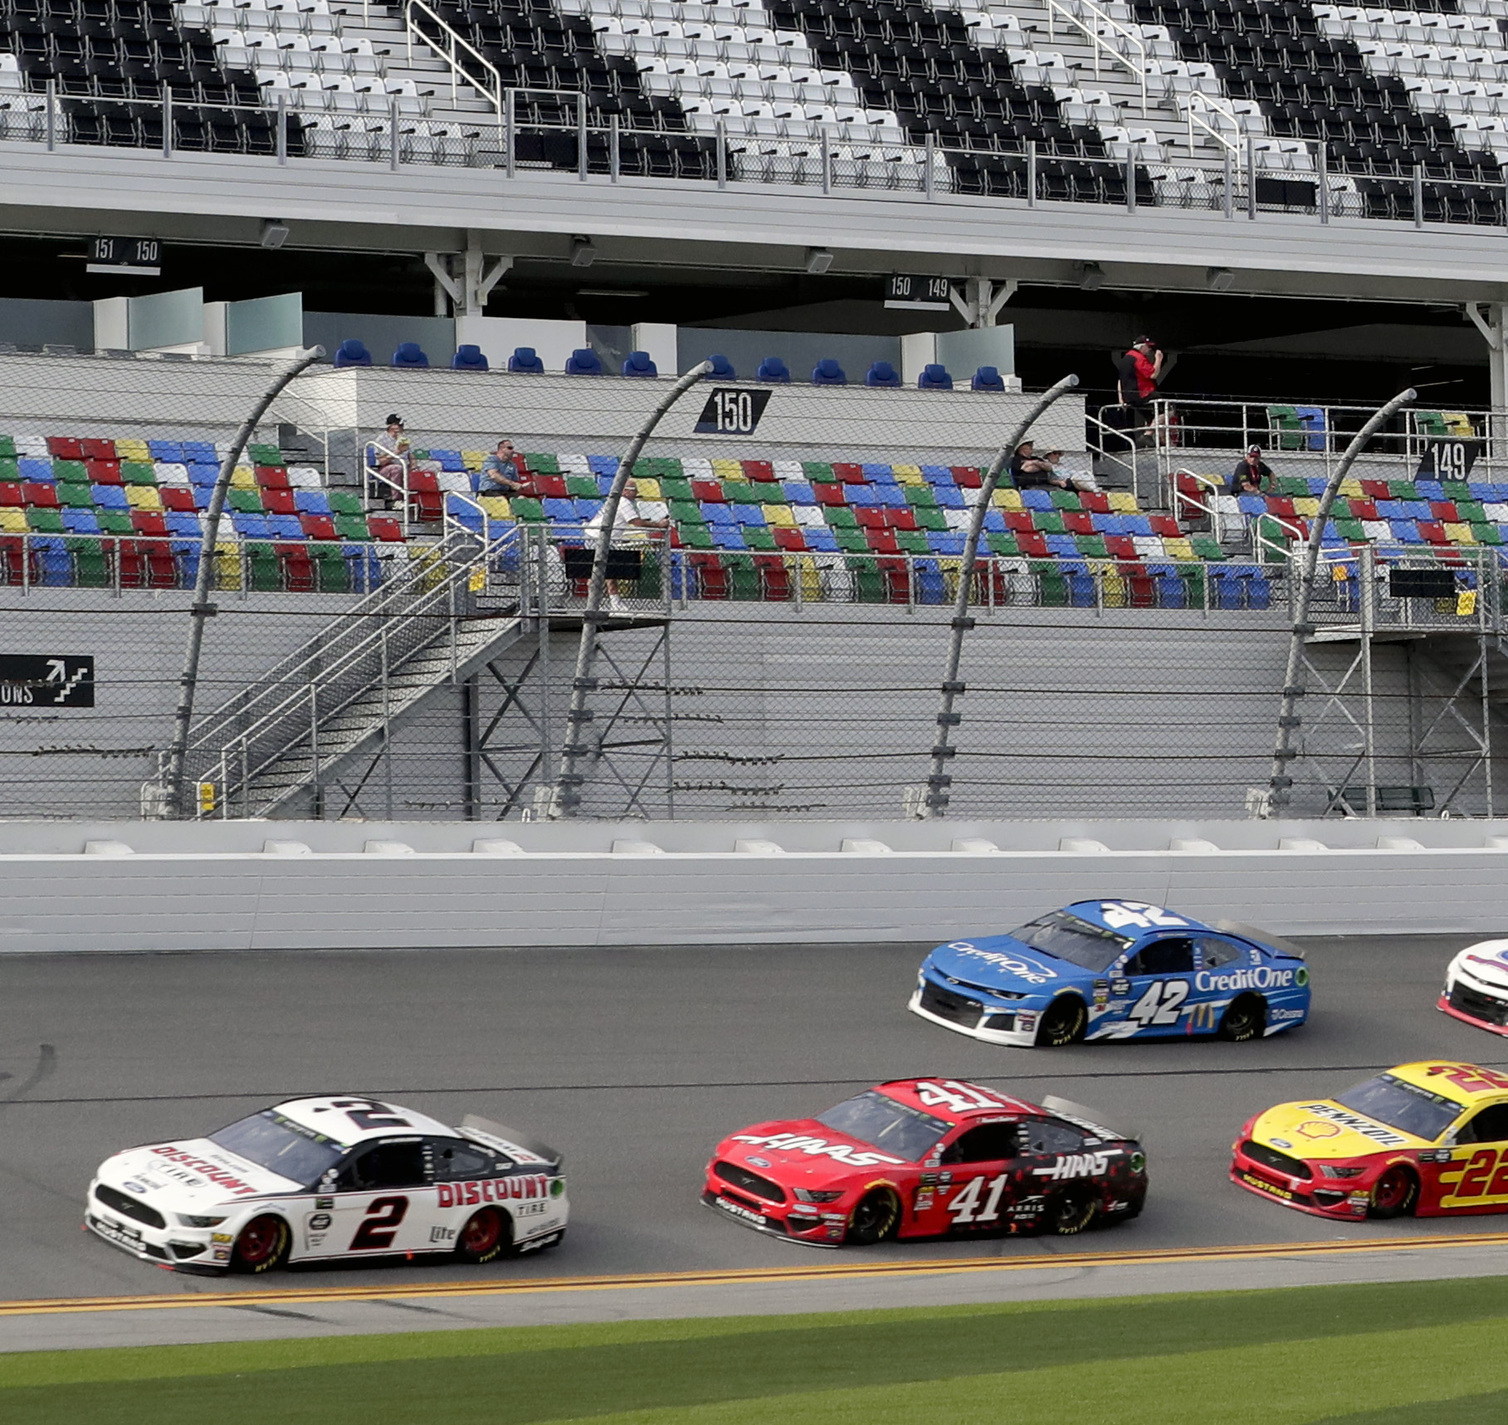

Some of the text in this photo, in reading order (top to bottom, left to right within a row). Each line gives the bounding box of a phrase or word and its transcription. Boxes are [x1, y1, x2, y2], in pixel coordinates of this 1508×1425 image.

[95, 238, 158, 261] 151 150
[892, 276, 948, 297] 150 149
[703, 391, 752, 432] 150
[1431, 442, 1466, 481] 149
[1101, 902, 1190, 929] 42
[1195, 964, 1294, 993] CreditOne
[1127, 978, 1190, 1026] 42
[915, 1080, 1006, 1114] 41
[331, 1100, 415, 1131] 2
[1298, 1104, 1409, 1147] PENNZOIL
[731, 1132, 907, 1167] HAAS
[1032, 1148, 1124, 1181] HAAS
[151, 1146, 260, 1195] DISCOUNT
[1243, 1174, 1293, 1200] MUSTANG
[437, 1175, 549, 1209] DISCOUNT
[947, 1174, 1009, 1225] 41
[349, 1194, 410, 1252] 2
[517, 1202, 547, 1217] TIRE
[715, 1196, 767, 1225] MUSTANG
[429, 1225, 456, 1244] Lite
